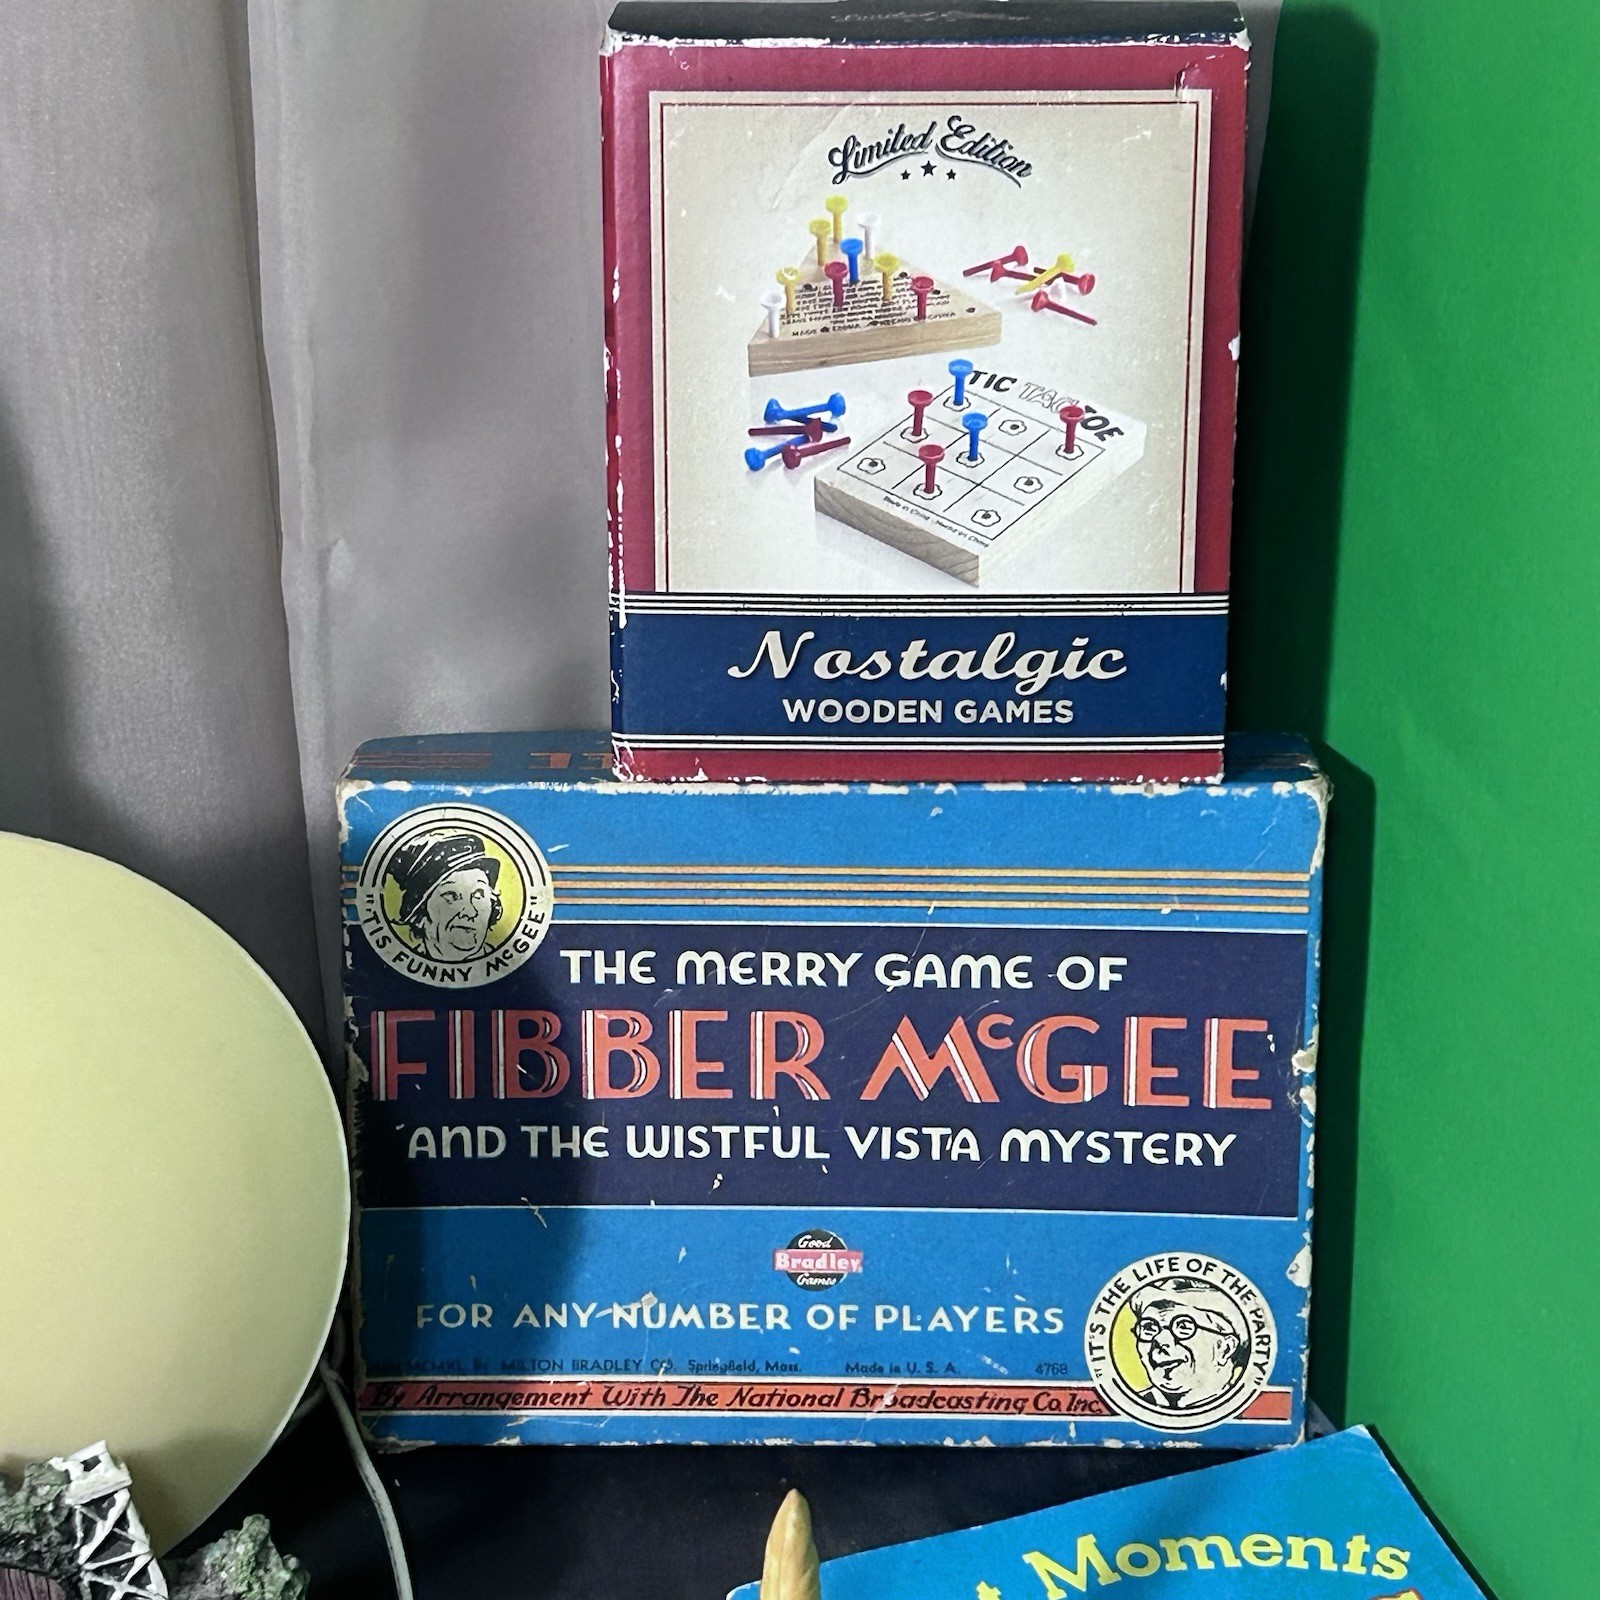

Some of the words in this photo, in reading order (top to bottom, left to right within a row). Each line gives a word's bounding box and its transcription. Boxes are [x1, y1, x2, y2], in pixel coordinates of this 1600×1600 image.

[828, 120, 938, 185] Limited
[936, 115, 1033, 187] Edition
[968, 370, 1017, 392] TIC
[727, 630, 1127, 696] Nostalgic
[782, 699, 942, 724] WOODEN
[954, 699, 1074, 724] GAMES
[392, 950, 473, 983] FUNNY
[559, 949, 656, 985] THE
[676, 950, 864, 987] MERRY
[874, 953, 1034, 991] GAME
[1056, 956, 1128, 991] OF
[370, 1009, 831, 1101] FIBBER
[860, 1013, 1272, 1109] McGEE
[408, 1125, 507, 1159] AND
[521, 1125, 609, 1159] THE
[626, 1124, 831, 1160] WISTFUL
[845, 1126, 981, 1162] VISTA
[1000, 1128, 1237, 1167] MYSTERY
[798, 1234, 833, 1249] Good
[774, 1251, 862, 1273] Bradley
[796, 1272, 836, 1285] Games
[1095, 1277, 1131, 1315] THE
[1132, 1256, 1180, 1281] LIFE
[1186, 1258, 1217, 1276] OF
[1220, 1268, 1257, 1306] THE
[416, 1303, 493, 1330] FOR
[513, 1303, 598, 1329] ANY
[612, 1303, 790, 1332] NUMBER
[806, 1303, 859, 1331] OF
[875, 1304, 1065, 1335] PLAYERS
[501, 1358, 564, 1372] MILTON
[572, 1358, 643, 1372] BRADLEY
[845, 1361, 885, 1374] Made
[906, 1361, 921, 1375] U.
[925, 1361, 939, 1375] S.
[944, 1361, 961, 1375] A.
[1035, 1363, 1068, 1376] 4768
[371, 1384, 407, 1409] By
[415, 1384, 594, 1411] Arrangement
[602, 1385, 666, 1407] With
[672, 1384, 719, 1407] The
[726, 1386, 845, 1408] National
[849, 1387, 1030, 1415] Broadcasting
[1022, 1532, 1411, 1600] Moments
